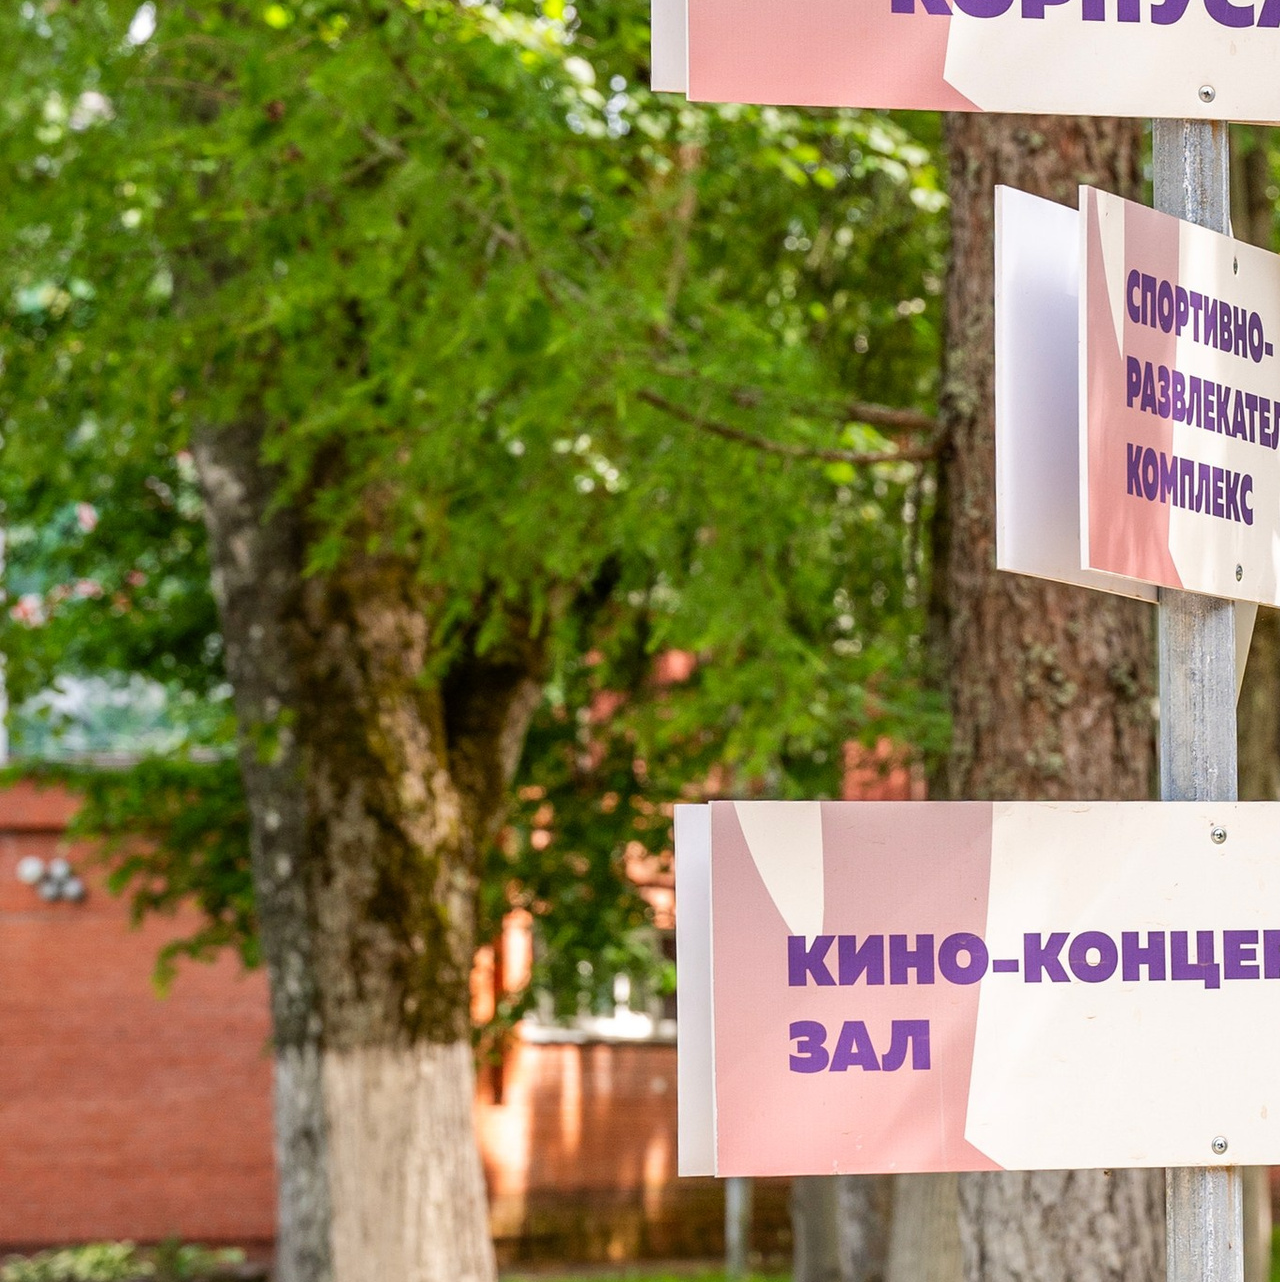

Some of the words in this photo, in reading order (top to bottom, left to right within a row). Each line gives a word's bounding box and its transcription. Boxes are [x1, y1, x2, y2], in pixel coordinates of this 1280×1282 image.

[1126, 268, 1274, 364] СПОРТИВНО-
[1126, 443, 1254, 526] КОМПЛЕКС
[787, 1019, 931, 1075] ЗАЛ
